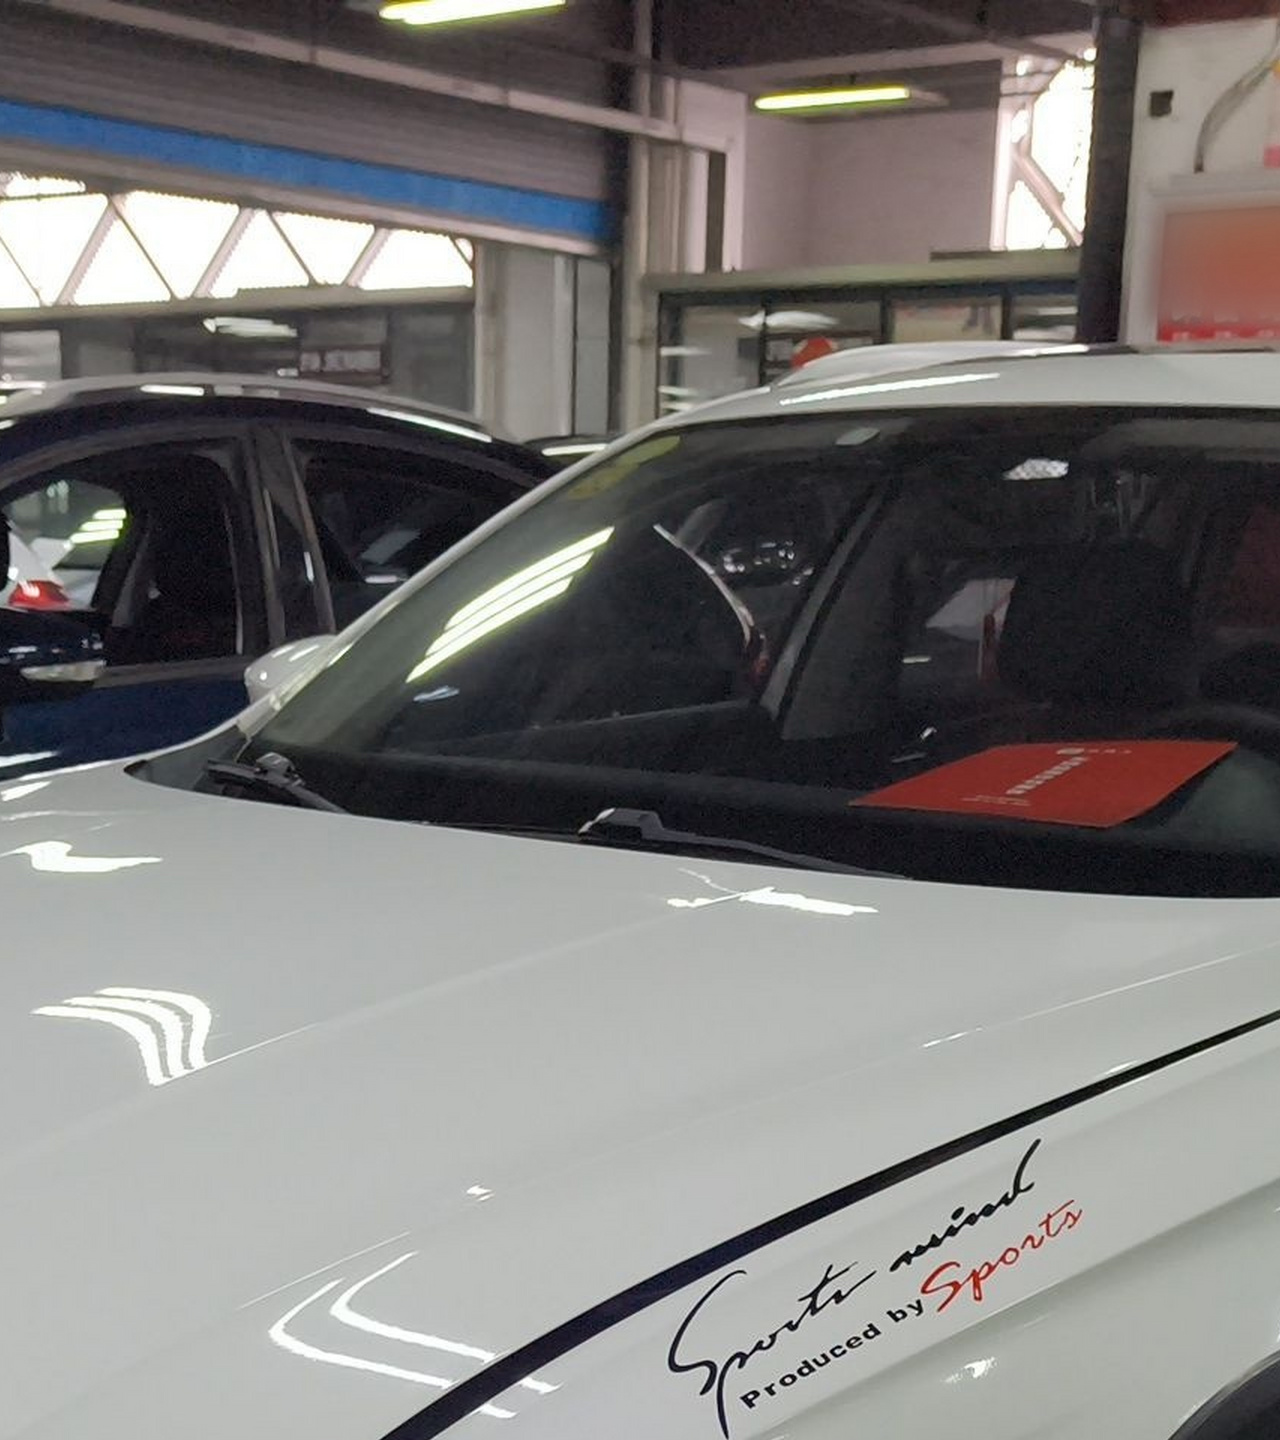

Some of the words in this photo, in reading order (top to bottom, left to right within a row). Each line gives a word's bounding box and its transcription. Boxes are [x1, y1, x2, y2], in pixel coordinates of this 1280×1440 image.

[740, 1323, 882, 1408] Produced
[892, 1298, 924, 1323] by
[921, 1199, 1083, 1312] Sports
